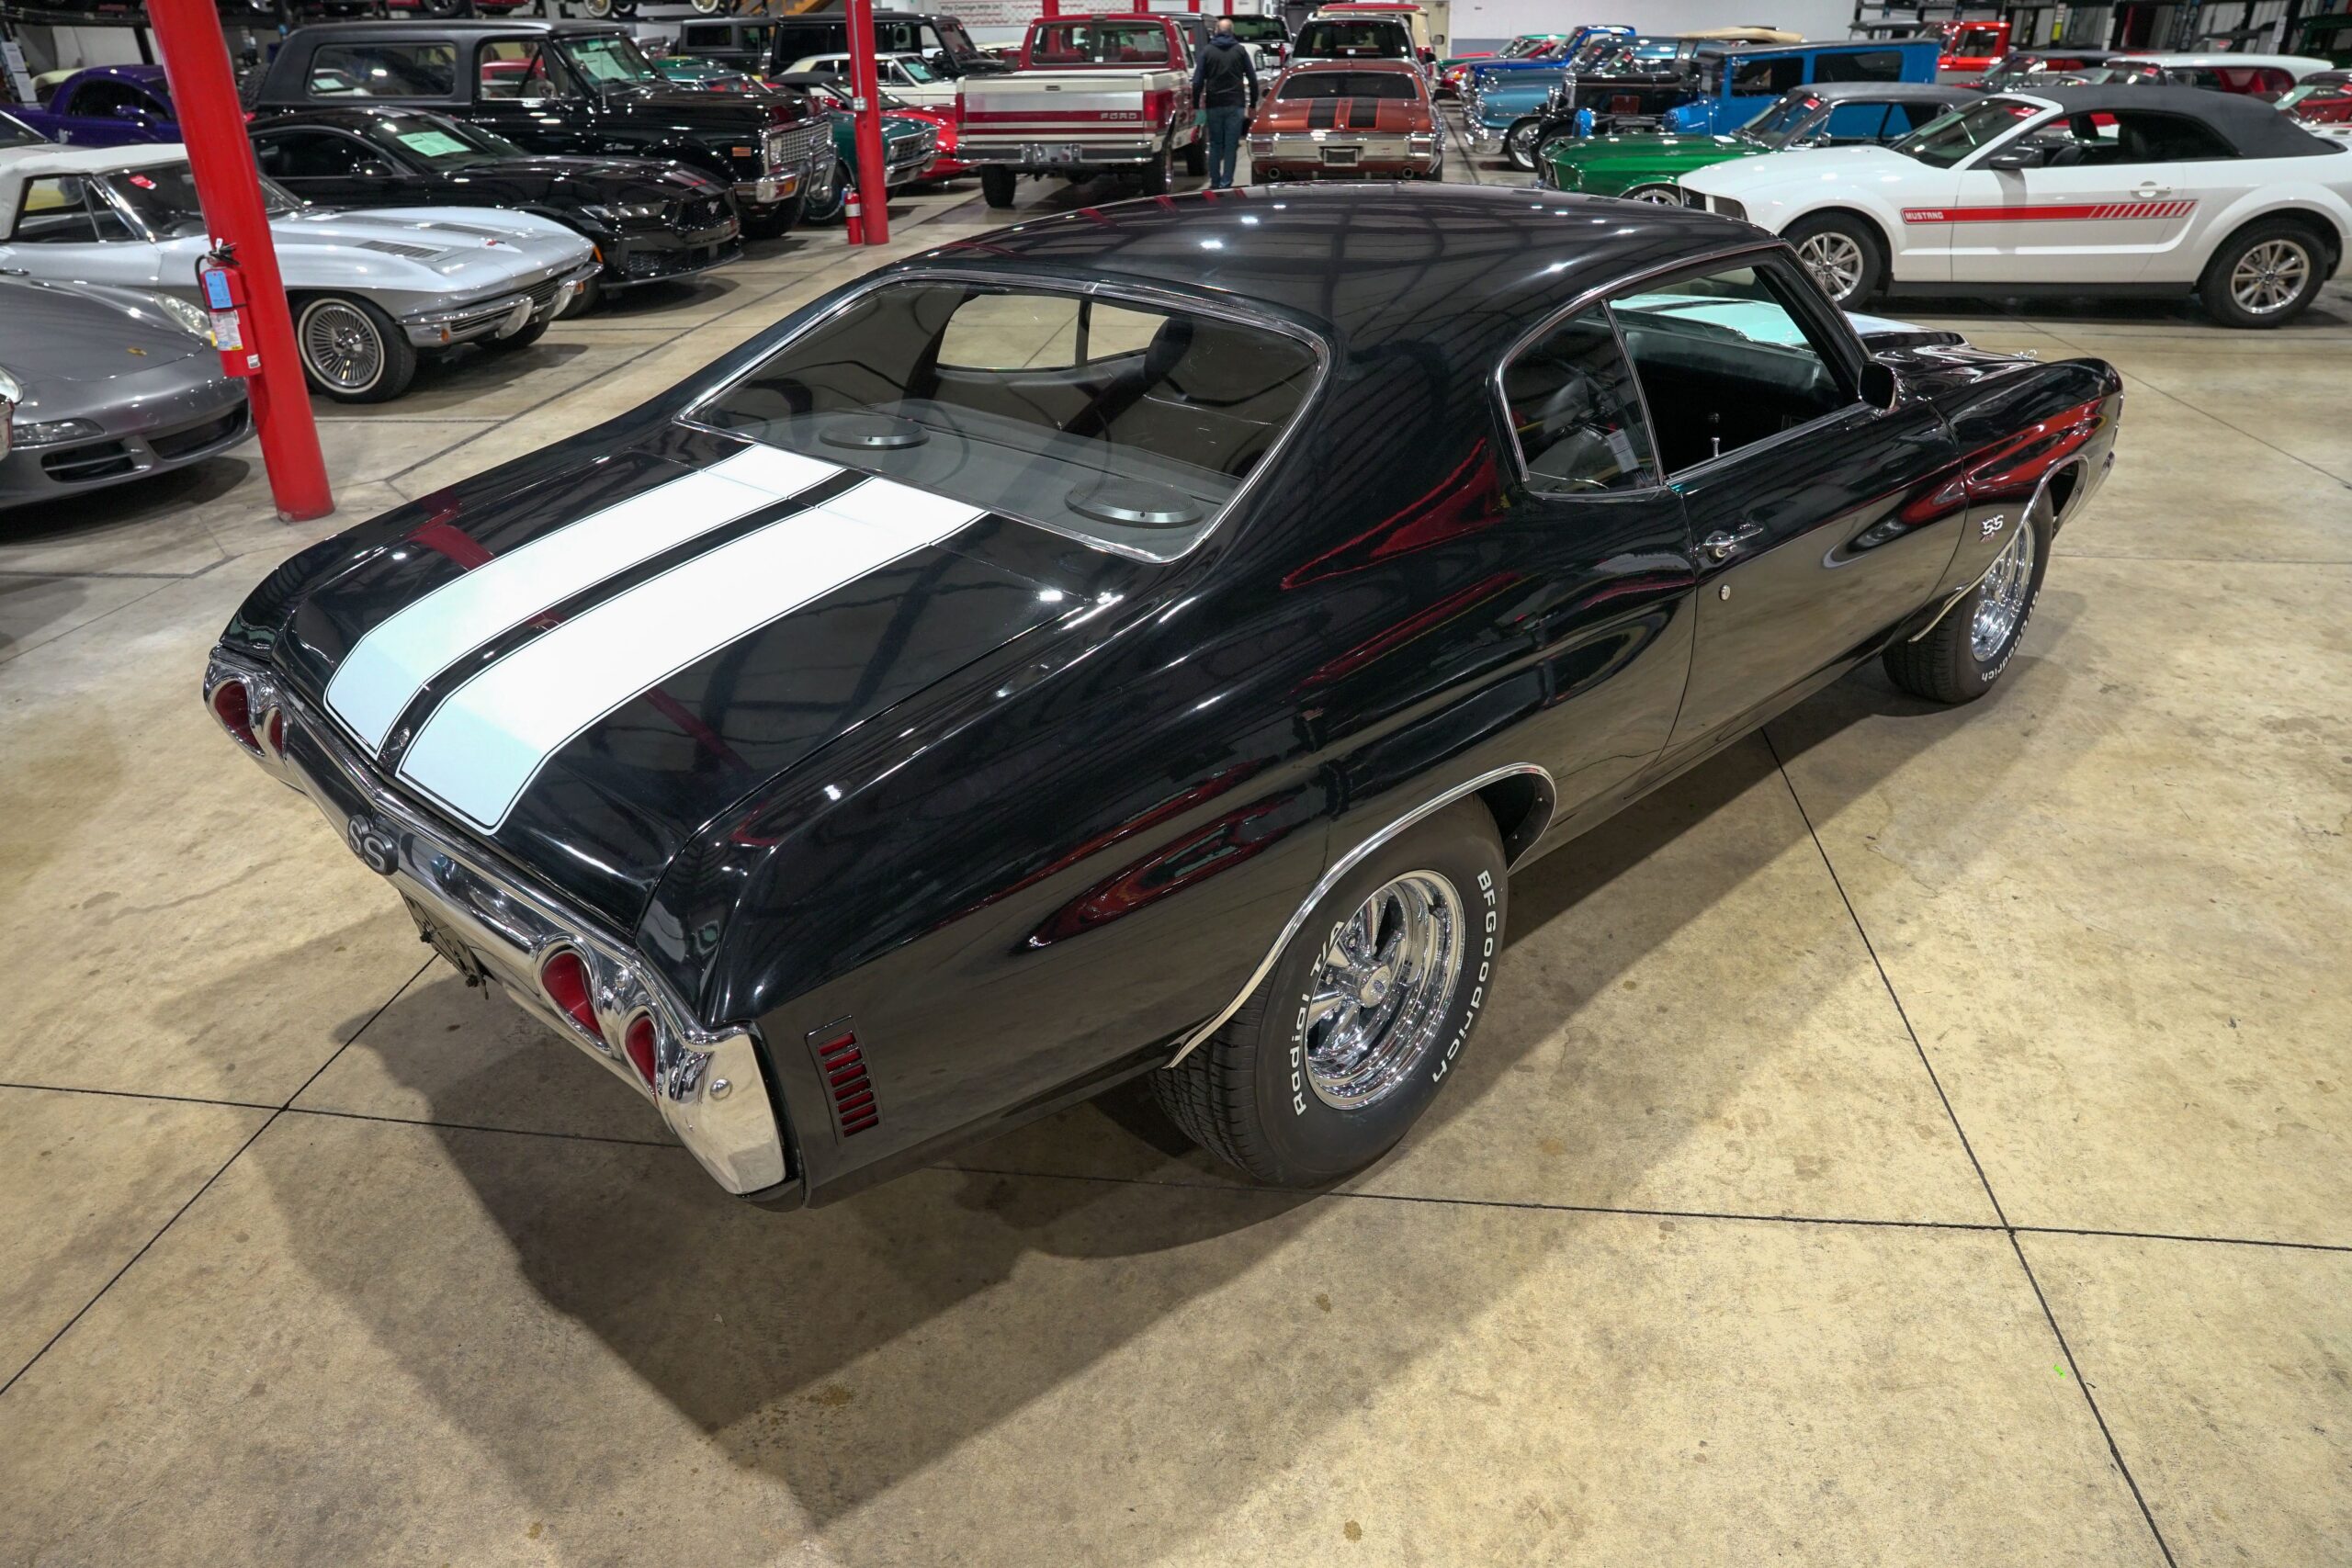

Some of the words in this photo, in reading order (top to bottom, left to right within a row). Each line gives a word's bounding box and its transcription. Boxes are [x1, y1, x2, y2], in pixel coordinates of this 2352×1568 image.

[1904, 211, 1944, 220] MUSTANG
[348, 815, 395, 874] SS
[1432, 870, 1497, 1083] BFGoodrich
[1290, 993, 1311, 1116] Radial
